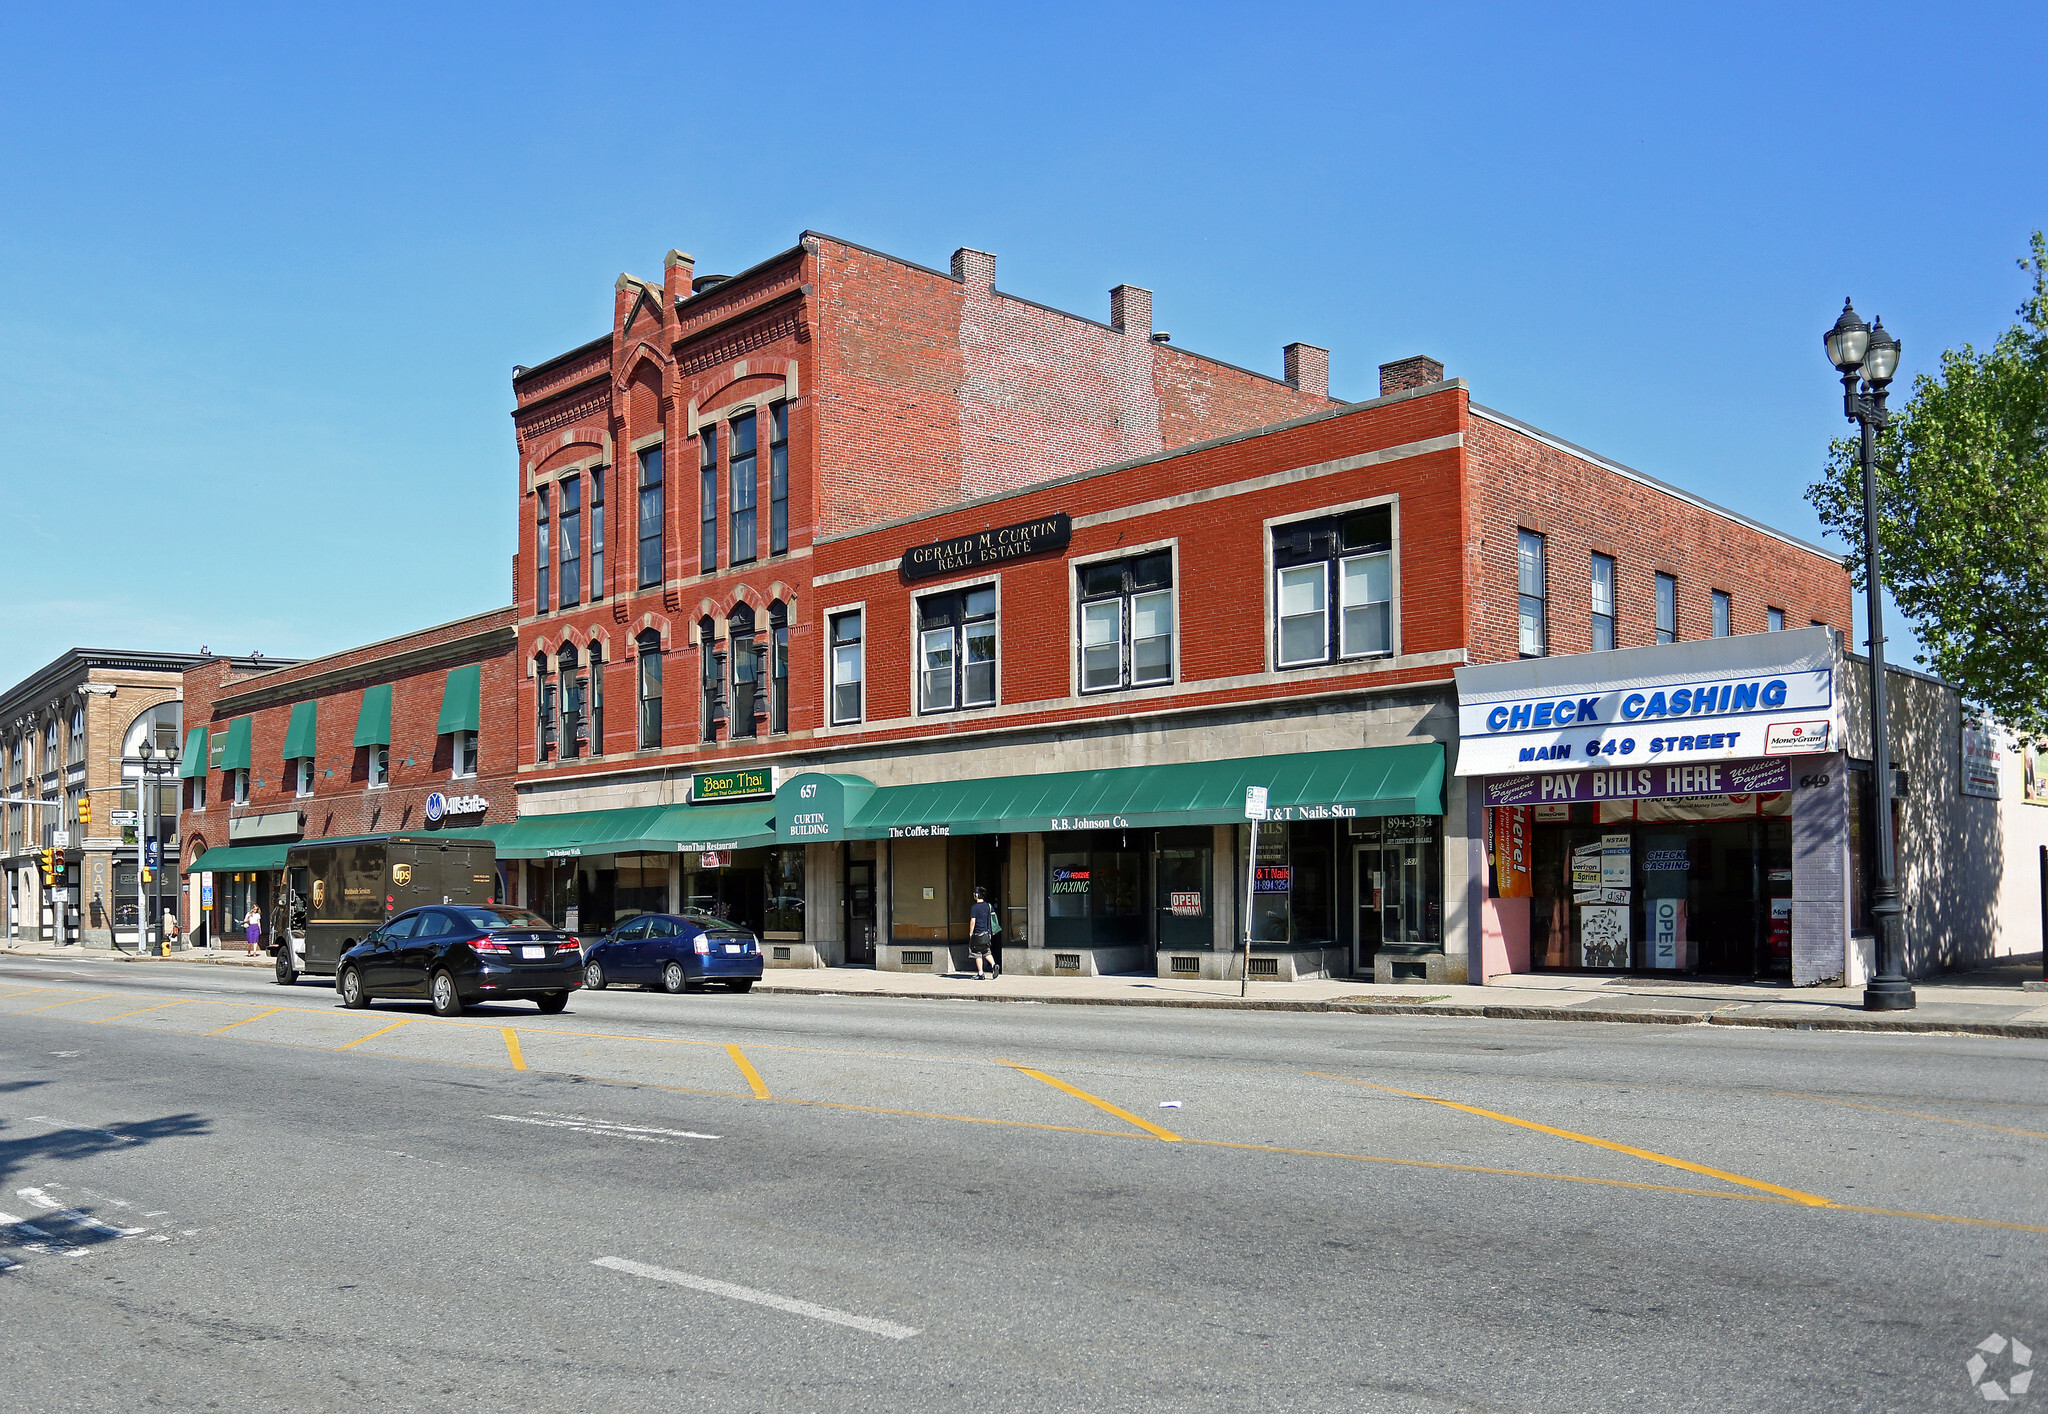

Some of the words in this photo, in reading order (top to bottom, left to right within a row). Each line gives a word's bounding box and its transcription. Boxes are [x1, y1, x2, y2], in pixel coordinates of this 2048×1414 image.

[913, 539, 973, 564] GERALD
[978, 533, 994, 549] M.
[998, 520, 1058, 545] CURTIN
[938, 555, 973, 571] REAL
[980, 540, 1032, 562] ESTATE
[1486, 696, 1600, 732] CHECK
[1620, 679, 1787, 721] CASHING
[1518, 744, 1571, 762] MAIN
[1586, 737, 1636, 757] 649
[1649, 732, 1741, 753] STREET
[1771, 735, 1822, 745] MoneyGram
[1729, 758, 1782, 778] Utilities
[703, 777, 733, 792] Baan
[736, 772, 762, 787] Thai
[1541, 773, 1580, 800] PAY
[1593, 769, 1651, 797] BILLS
[1666, 765, 1722, 793] HERE
[1732, 764, 1787, 787] Payment
[1800, 774, 1830, 788] 649
[1488, 775, 1530, 792] Utilities
[1490, 780, 1535, 799] Payment
[1743, 775, 1785, 791] Center
[800, 784, 817, 799] 657
[1248, 789, 1253, 798] 2
[1500, 790, 1533, 804] Center
[444, 794, 486, 815] Allstate
[794, 813, 824, 824] CURTIN
[1266, 807, 1292, 821] T&T
[1051, 818, 1071, 830] R.B.
[1072, 817, 1110, 830] Johnson
[1113, 816, 1129, 828] Co.
[1387, 816, 1433, 829] 894-3254
[790, 824, 829, 836] BUILDING
[889, 827, 903, 838] The
[905, 826, 929, 838] Coffee
[930, 825, 950, 836] Ring
[706, 841, 738, 850] Restaurant
[1512, 805, 1527, 873] Here!
[1647, 850, 1686, 860] CHECK
[1642, 860, 1690, 871] CASHING
[394, 870, 411, 883] ups
[1053, 868, 1070, 882] Spa
[1577, 873, 1597, 881] Sprint
[1052, 880, 1090, 893] WAXING
[1173, 894, 1198, 905] OPEN
[1659, 904, 1674, 957] OPEN
